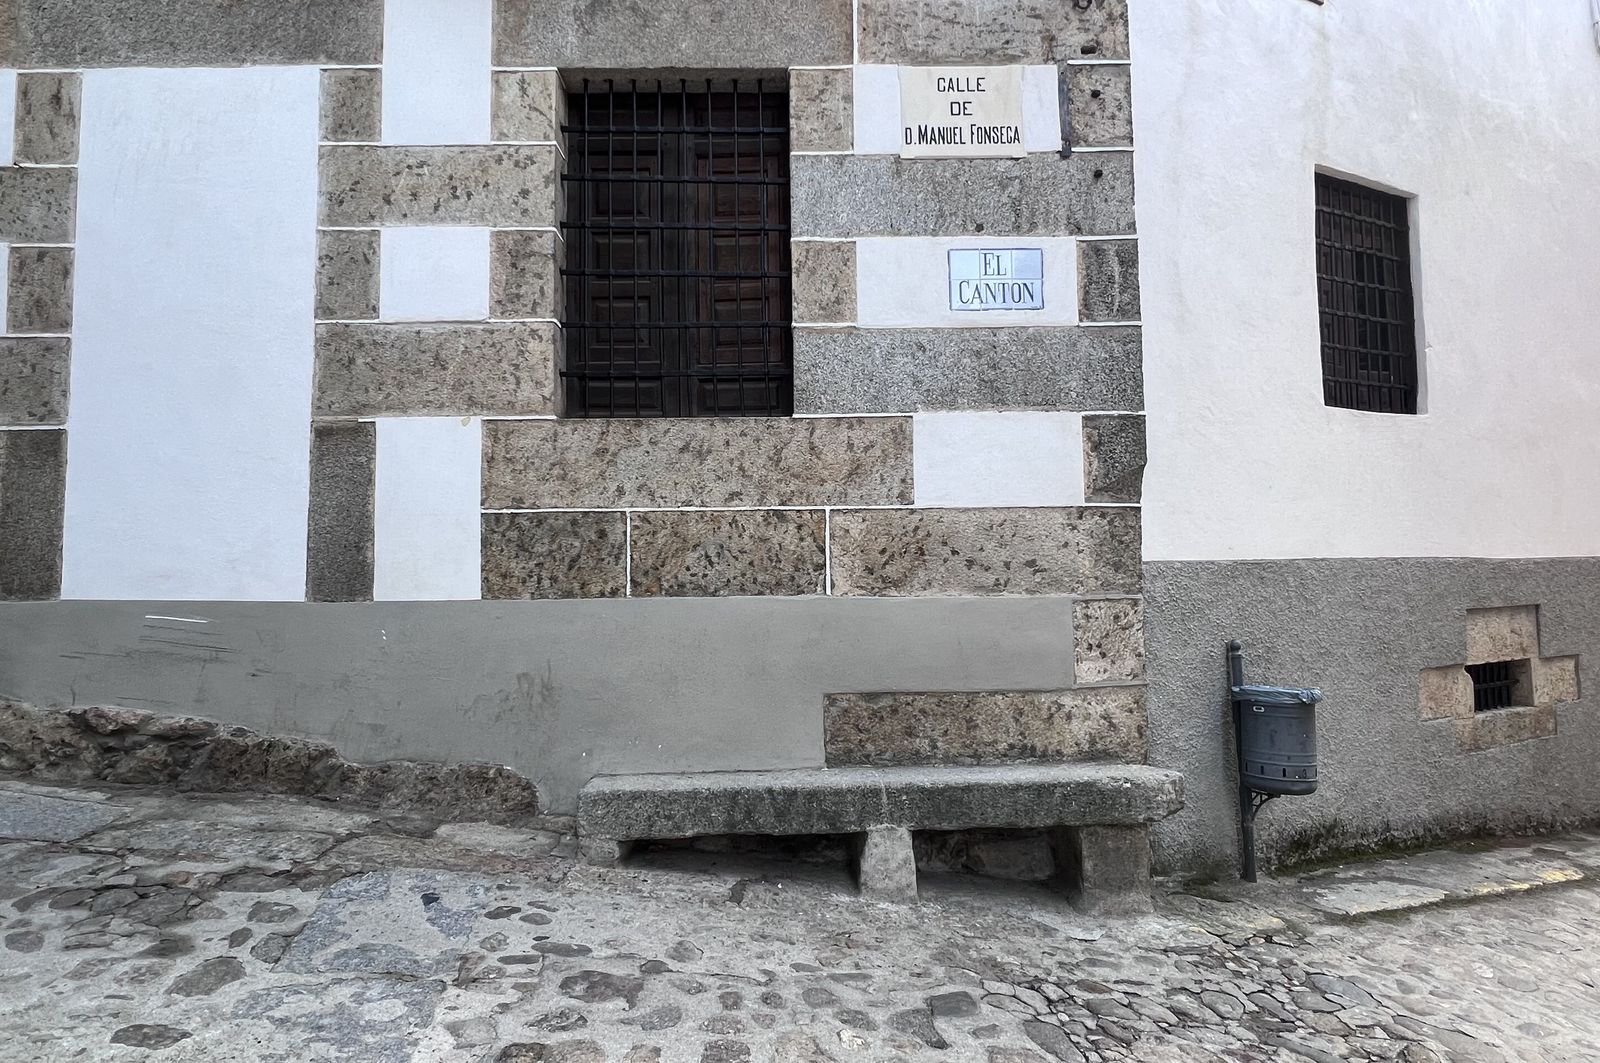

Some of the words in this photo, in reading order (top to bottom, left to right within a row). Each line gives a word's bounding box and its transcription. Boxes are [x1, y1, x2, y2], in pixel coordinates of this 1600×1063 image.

[937, 77, 986, 92] CALLE
[950, 101, 973, 116] DE
[970, 124, 1021, 144] FONSECA
[981, 252, 1007, 276] EL
[959, 280, 1034, 304] CANTON
